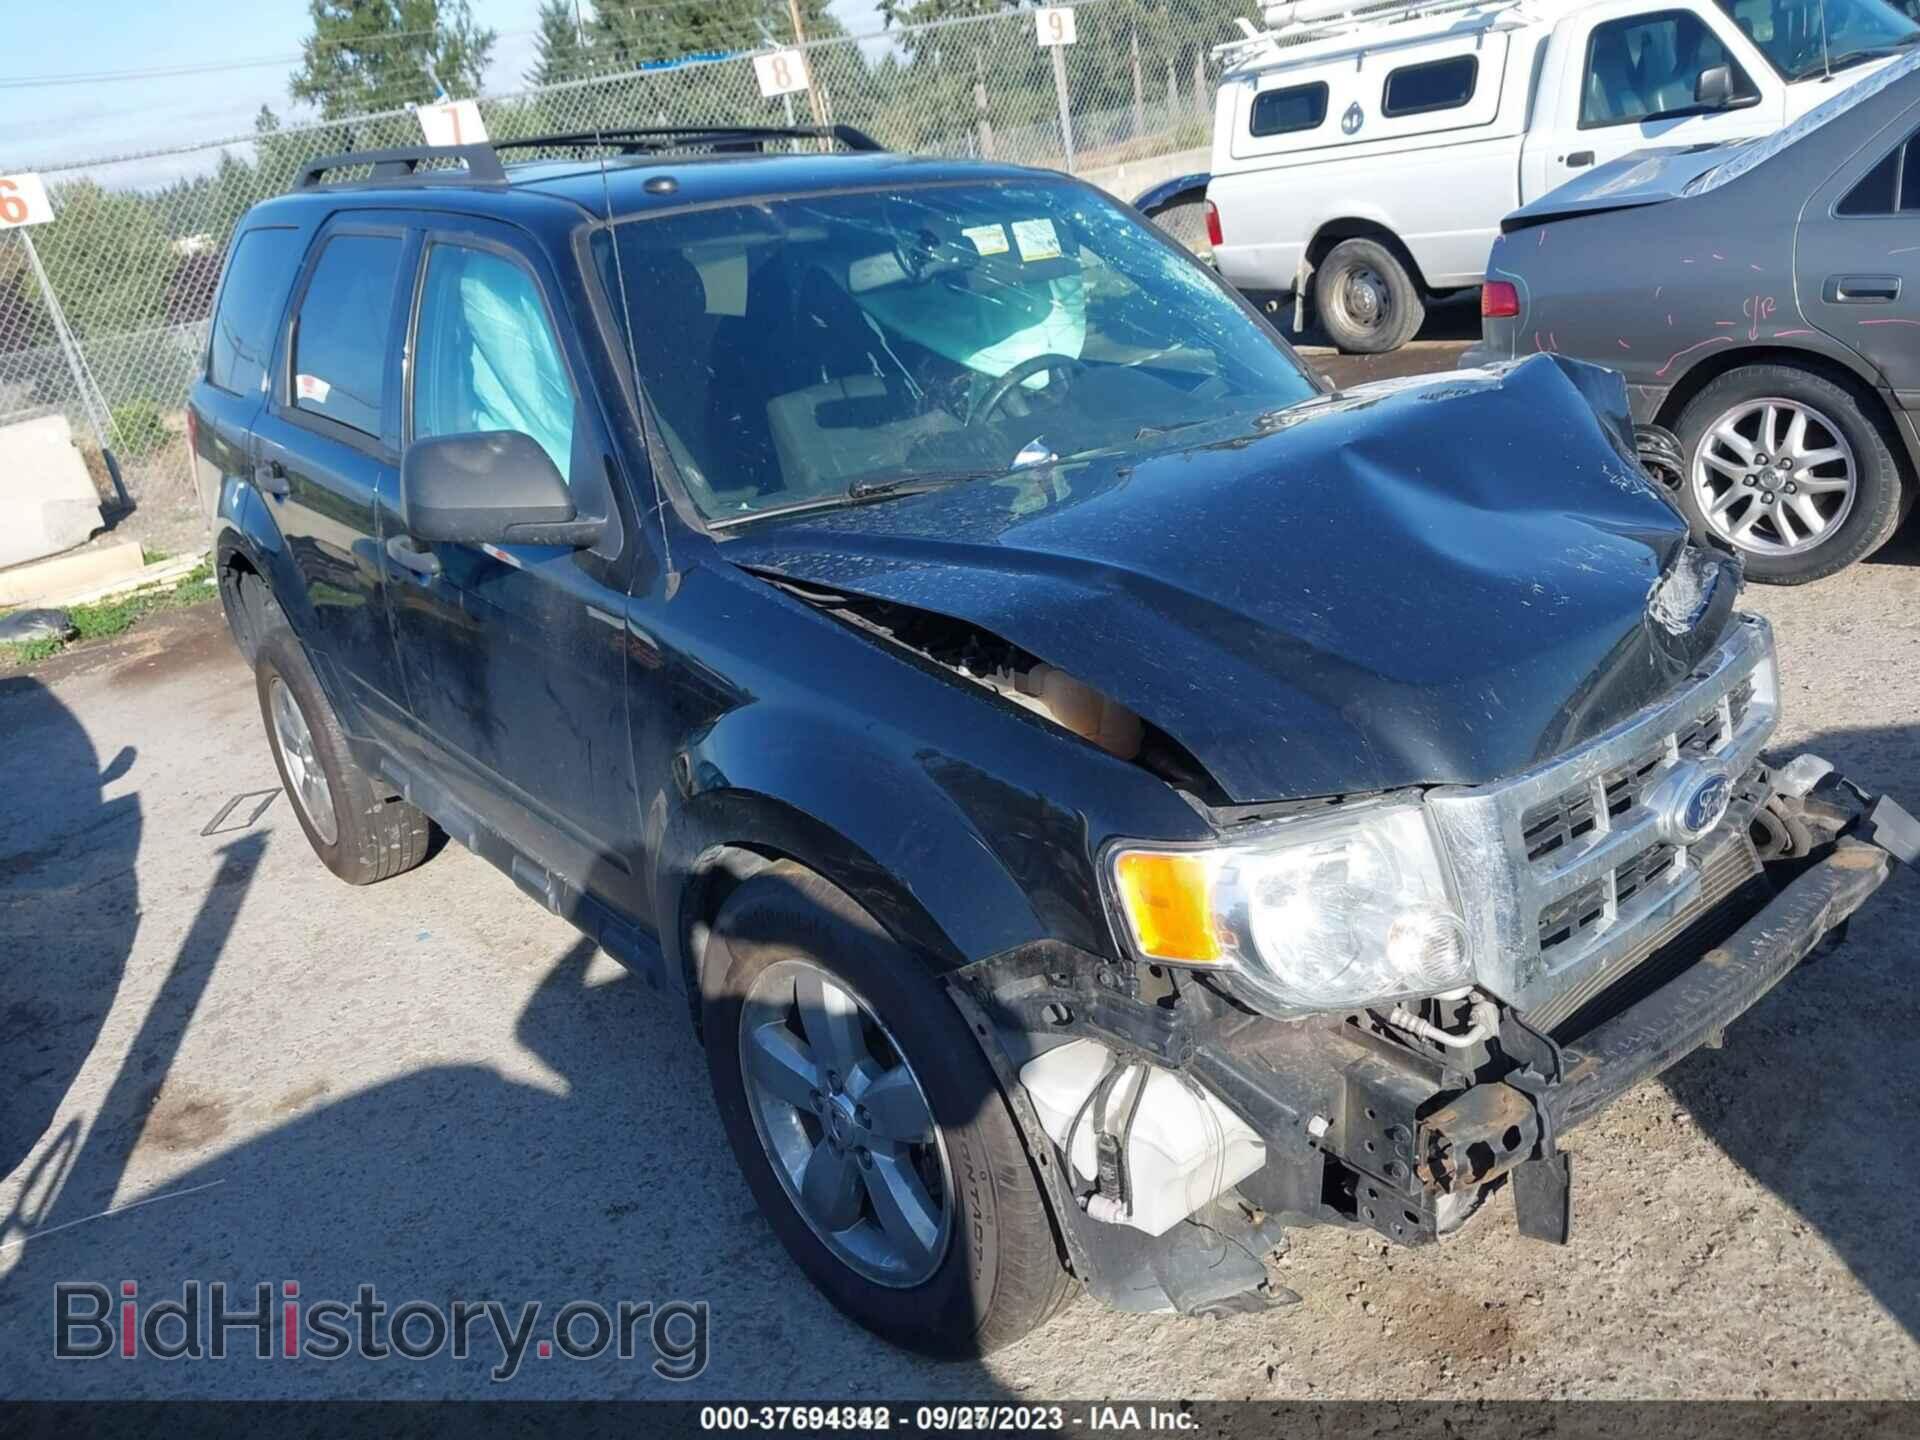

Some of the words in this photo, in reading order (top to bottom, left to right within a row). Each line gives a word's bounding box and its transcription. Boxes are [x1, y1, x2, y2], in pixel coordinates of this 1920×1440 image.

[1048, 11, 1063, 41] 9
[772, 56, 792, 88] 8
[0, 179, 28, 224] 6
